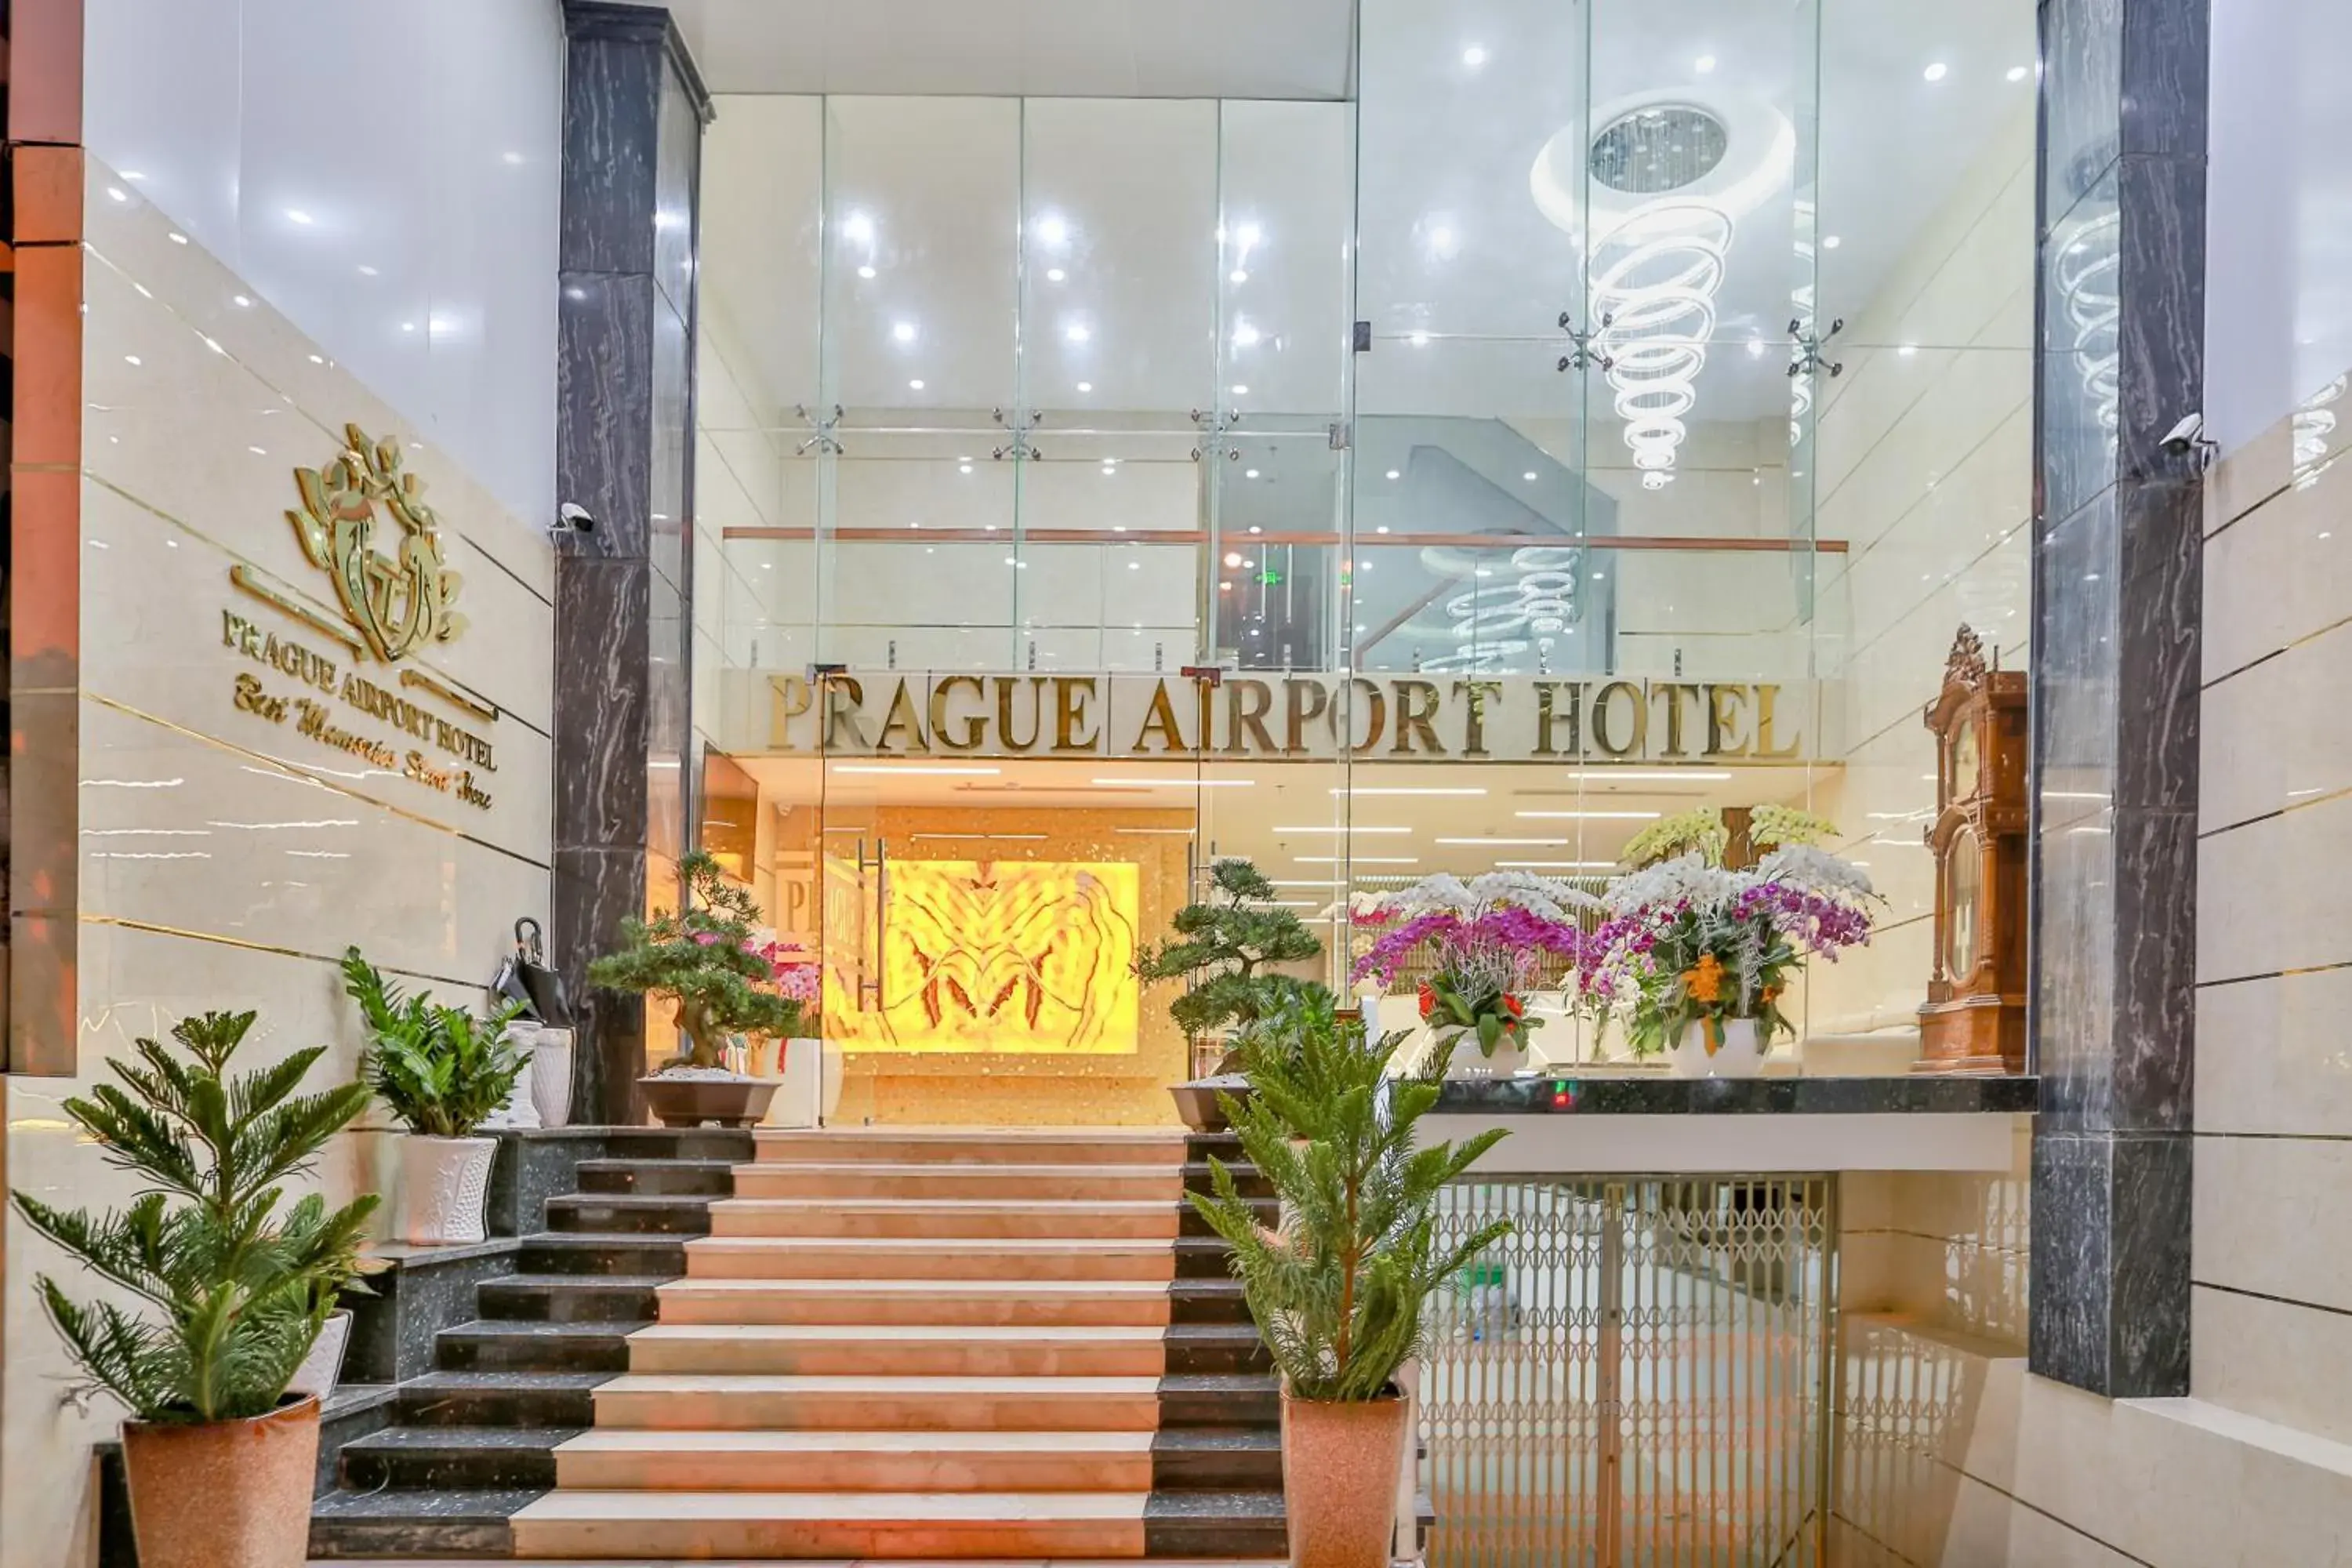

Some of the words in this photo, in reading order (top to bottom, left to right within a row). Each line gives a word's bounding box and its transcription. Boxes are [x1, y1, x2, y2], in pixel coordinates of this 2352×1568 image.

[223, 608, 337, 695] PRAGUE
[339, 671, 435, 741] AIRPORT
[436, 718, 498, 772] HOTEL
[767, 675, 1101, 752] PRAGUE
[1131, 676, 1503, 754] AIRPORT
[1531, 680, 1801, 758] HOTEL
